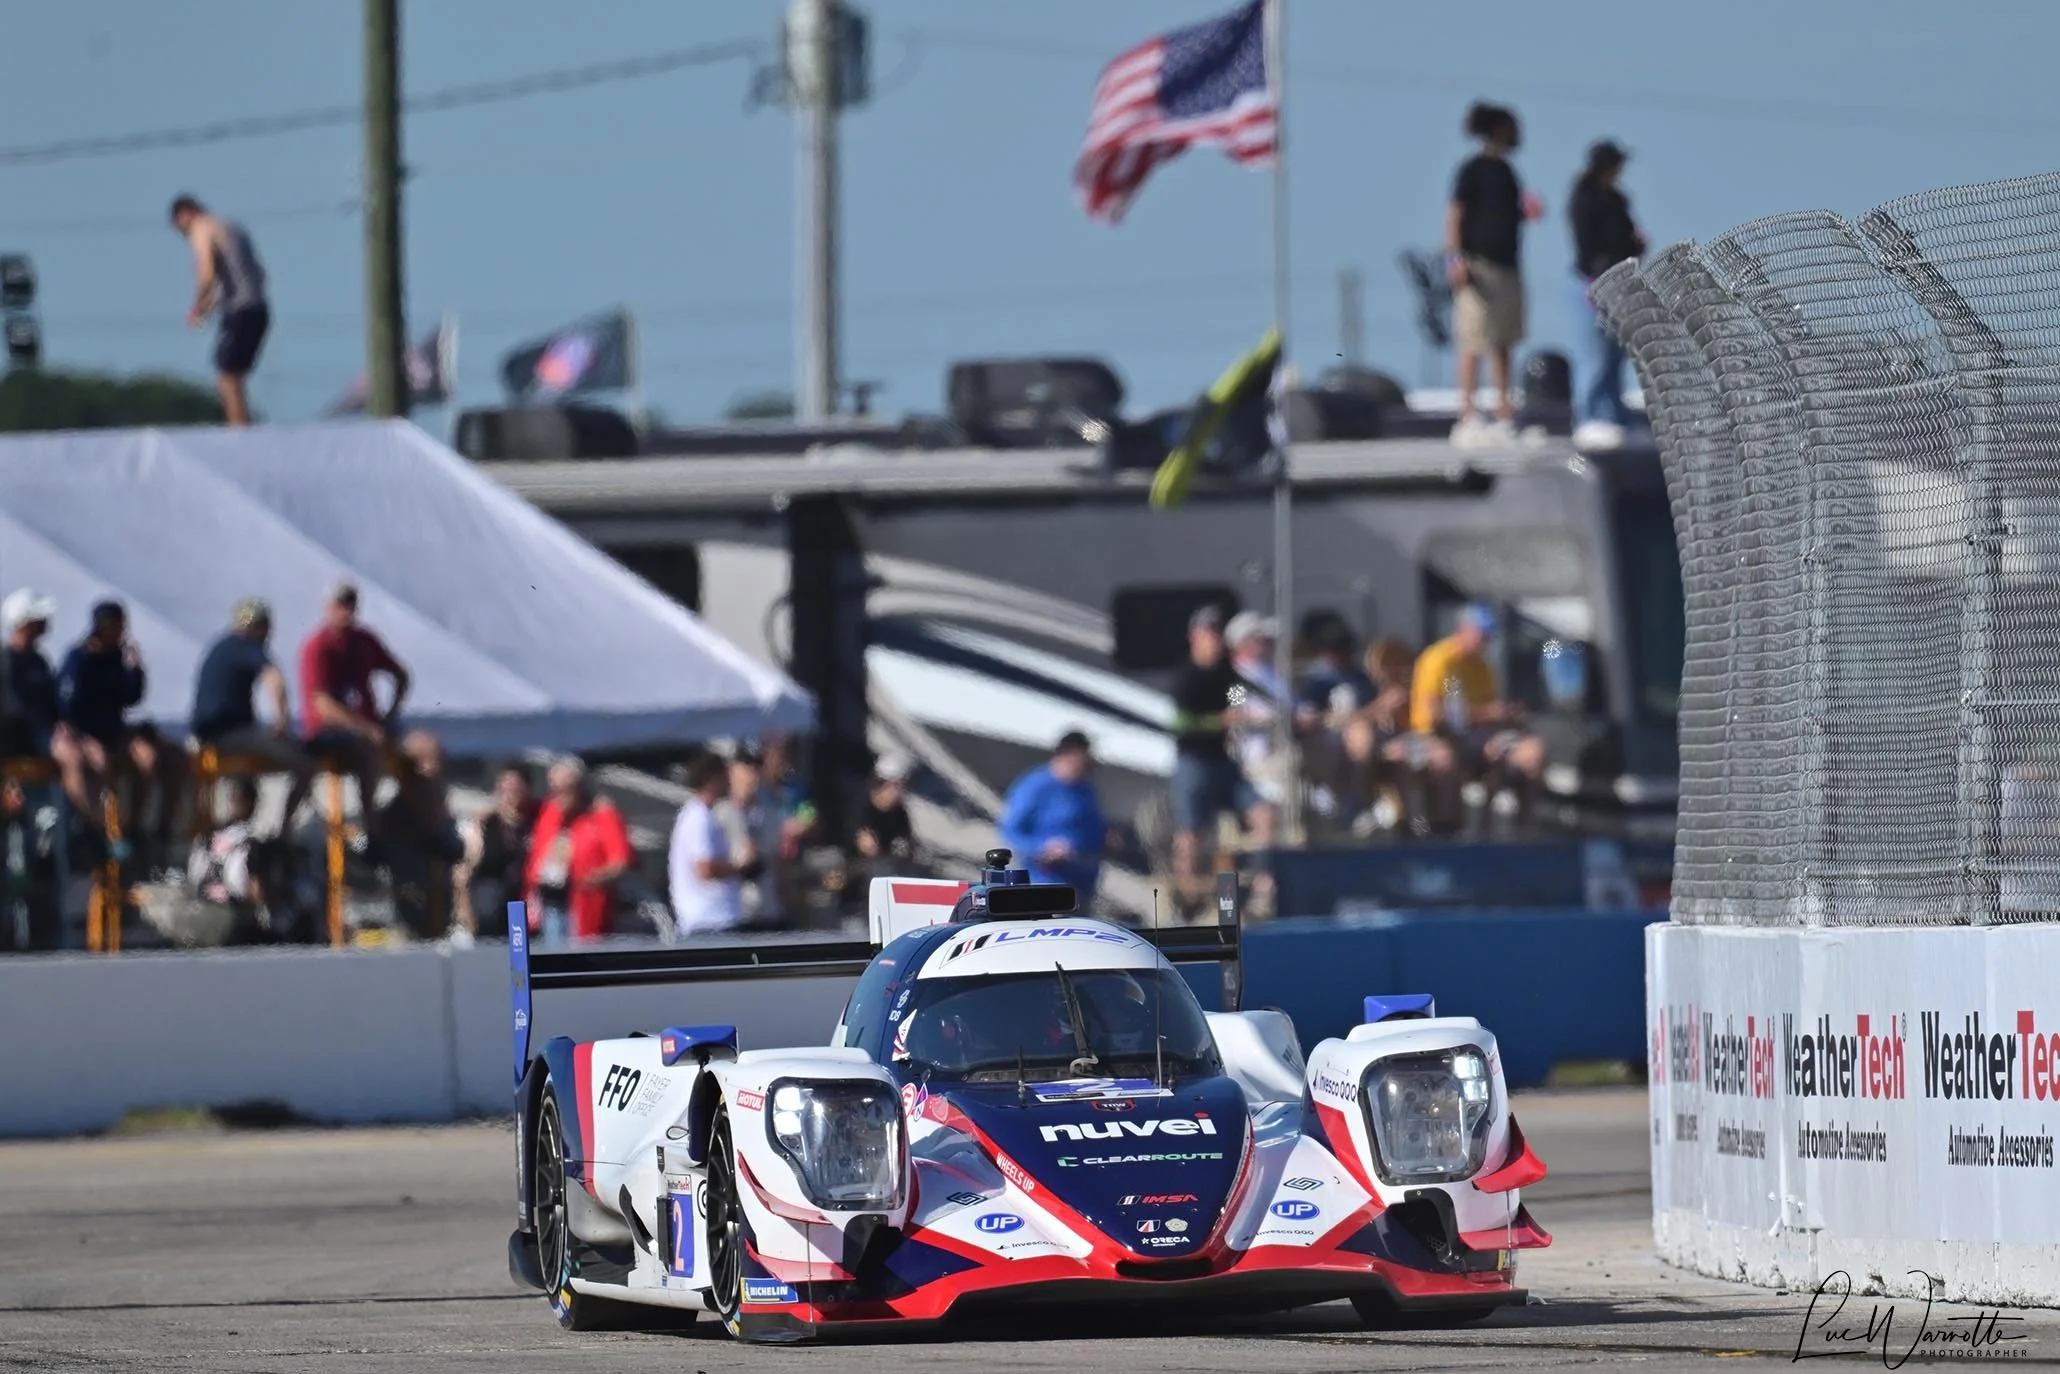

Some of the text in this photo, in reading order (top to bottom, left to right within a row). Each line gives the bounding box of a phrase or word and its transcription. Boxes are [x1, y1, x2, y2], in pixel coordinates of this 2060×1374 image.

[995, 928, 1128, 943] LMP2
[1703, 1012, 1774, 1099] WeatherTech
[1782, 1013, 1905, 1100] WeatherTech
[598, 1064, 641, 1111] FFO
[1340, 1081, 1357, 1102] QQQ
[737, 1091, 763, 1110] MOTUL
[1039, 1112, 1217, 1142] nuvei
[1798, 1118, 1887, 1163] Automotive Accessories
[1948, 1122, 2054, 1168] Automotive Accessories
[1083, 1152, 1223, 1164] CLEARROUTE
[996, 1152, 1035, 1192] WHEELS UP
[1142, 1194, 1198, 1204] IMSA
[1277, 1204, 1313, 1216] UP
[981, 1216, 1018, 1230] UP
[673, 1199, 685, 1271] 2
[1150, 1236, 1190, 1244] ORECA
[750, 1286, 788, 1296] MICHELIN
